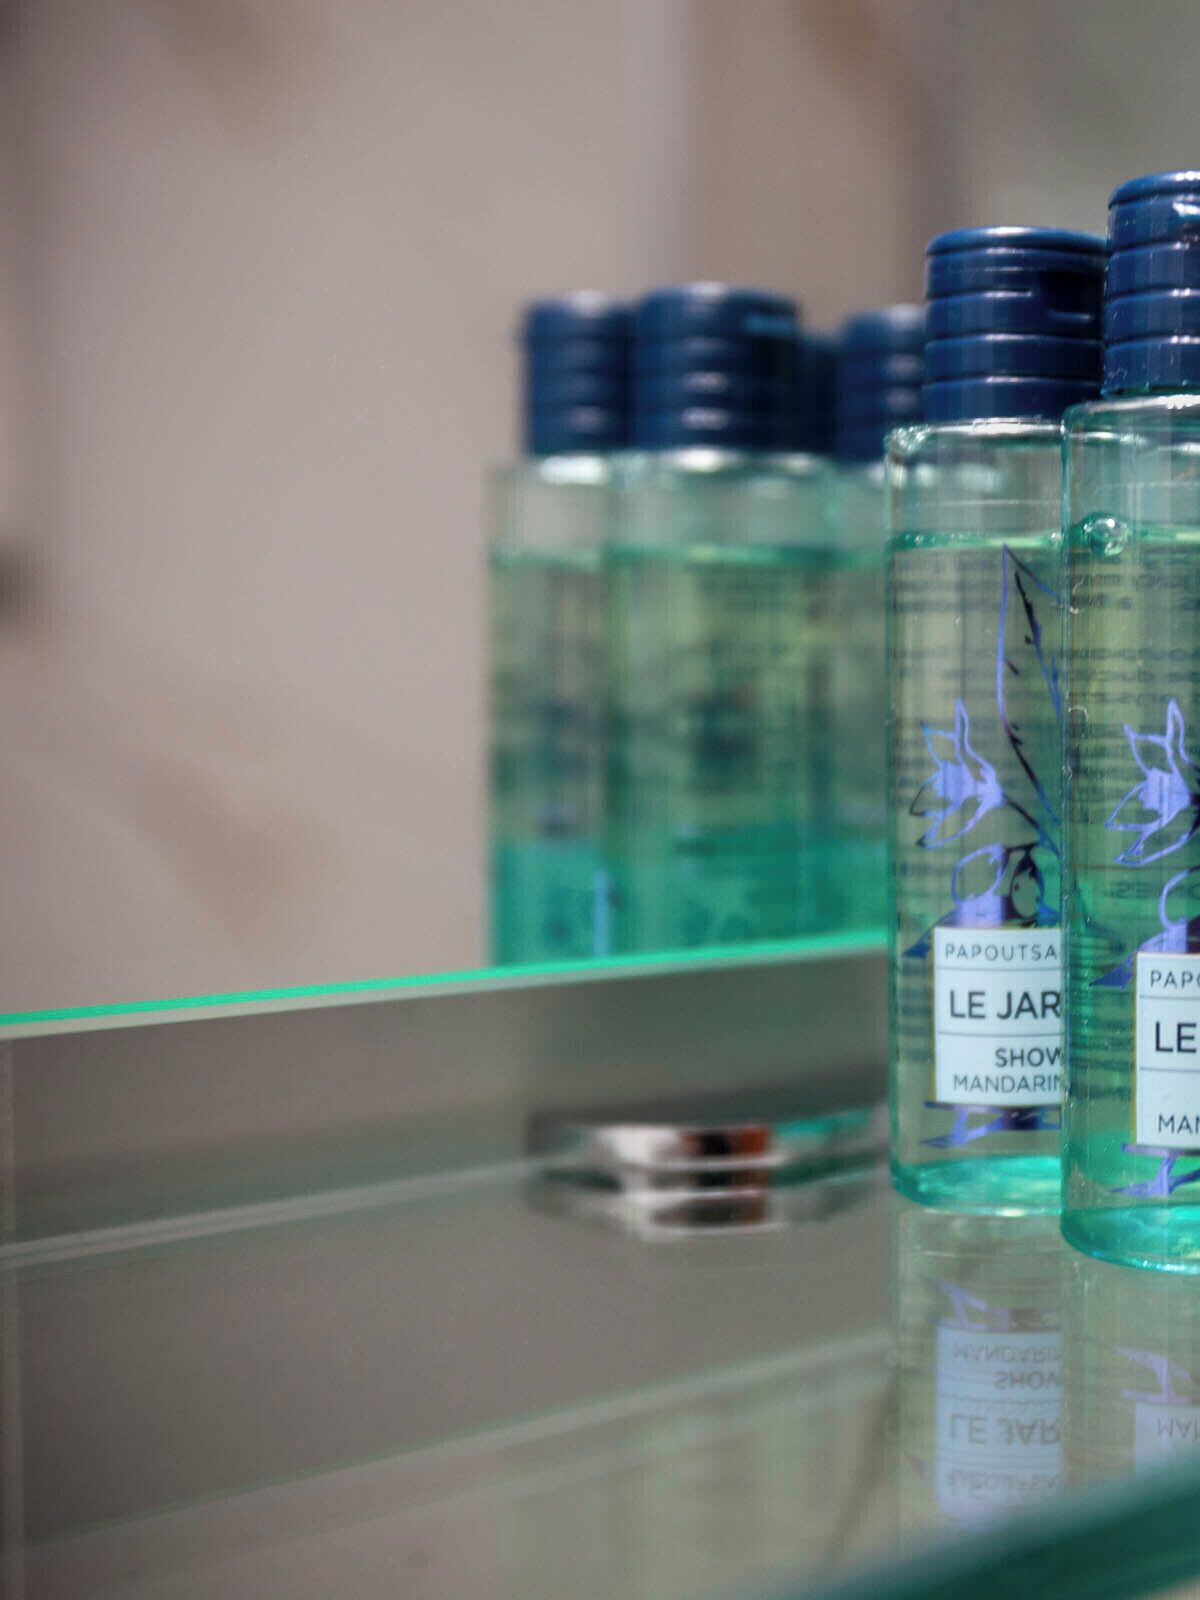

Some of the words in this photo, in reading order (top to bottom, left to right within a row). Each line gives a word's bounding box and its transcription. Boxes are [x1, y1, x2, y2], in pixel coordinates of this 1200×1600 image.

[945, 943, 1058, 961] PAPOUTSA
[951, 990, 987, 1019] LE
[997, 991, 1061, 1019] JAR
[1155, 1021, 1197, 1053] LE
